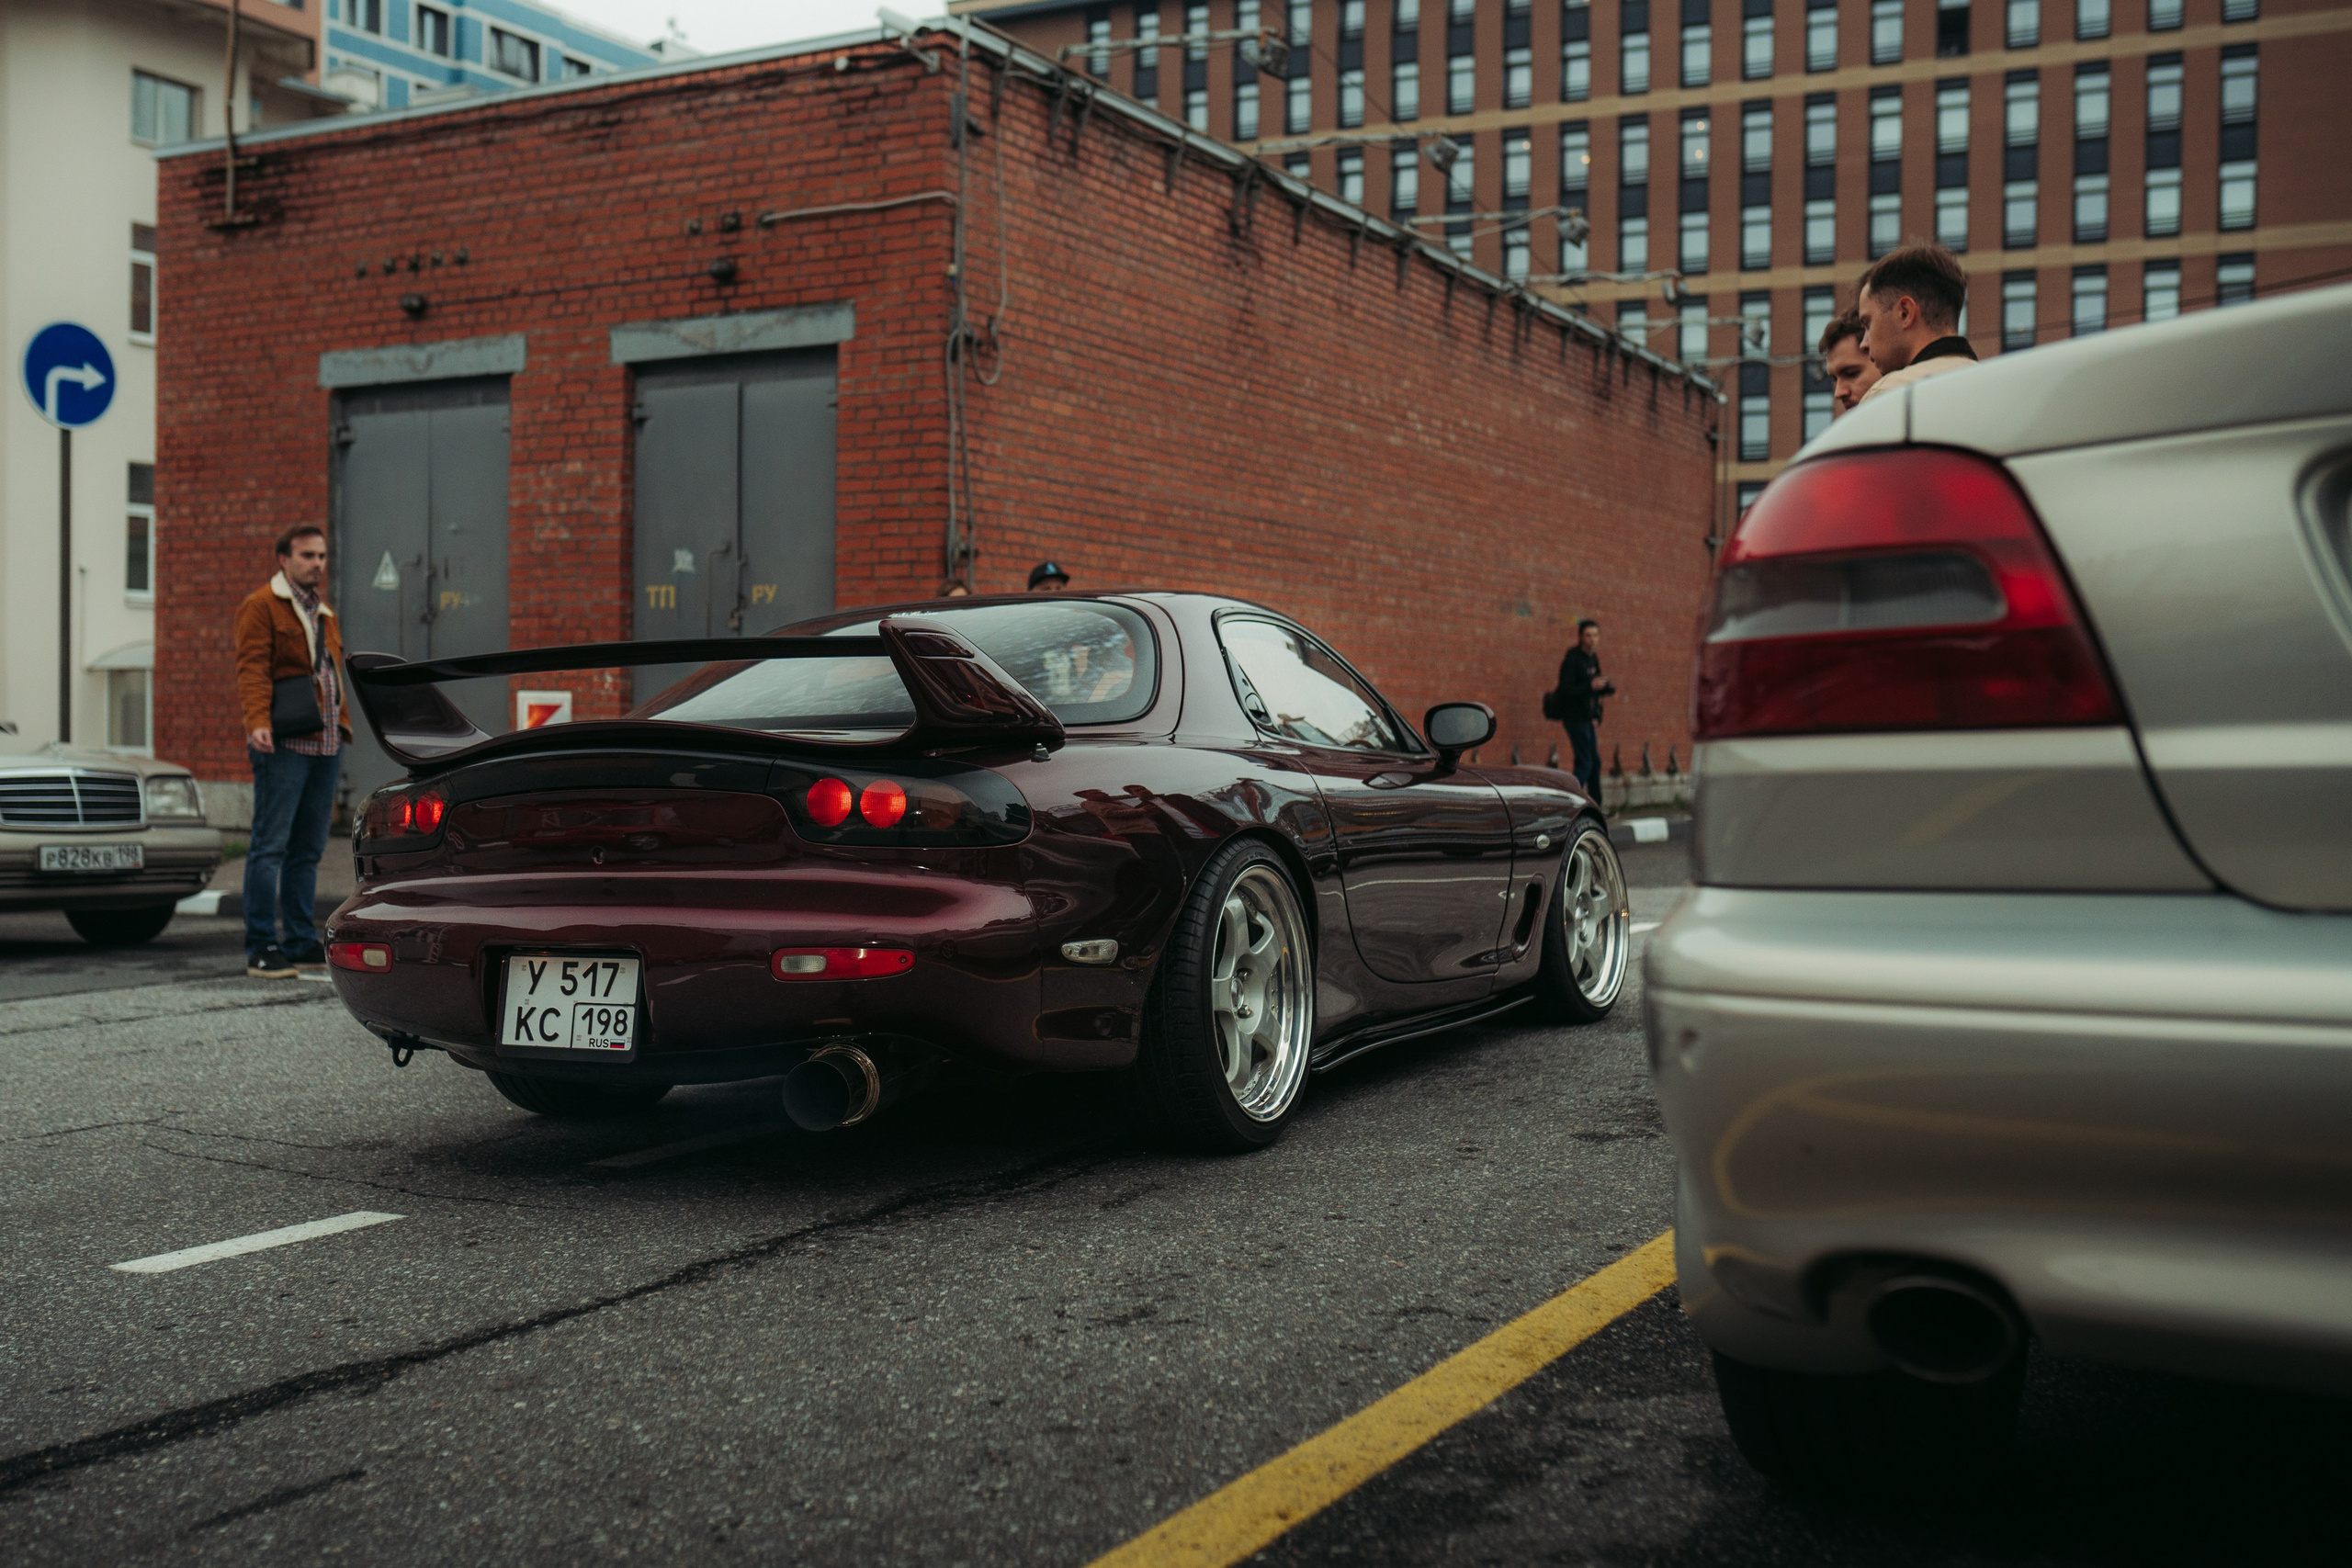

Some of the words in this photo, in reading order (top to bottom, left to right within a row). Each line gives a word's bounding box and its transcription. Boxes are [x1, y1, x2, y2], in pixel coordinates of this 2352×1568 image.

[645, 585, 675, 610] ТП
[752, 584, 777, 604] РУ
[528, 961, 548, 995] У
[560, 962, 619, 997] 517
[515, 1007, 560, 1042] КС
[582, 1008, 628, 1036] 198
[589, 1038, 609, 1048] RUS
